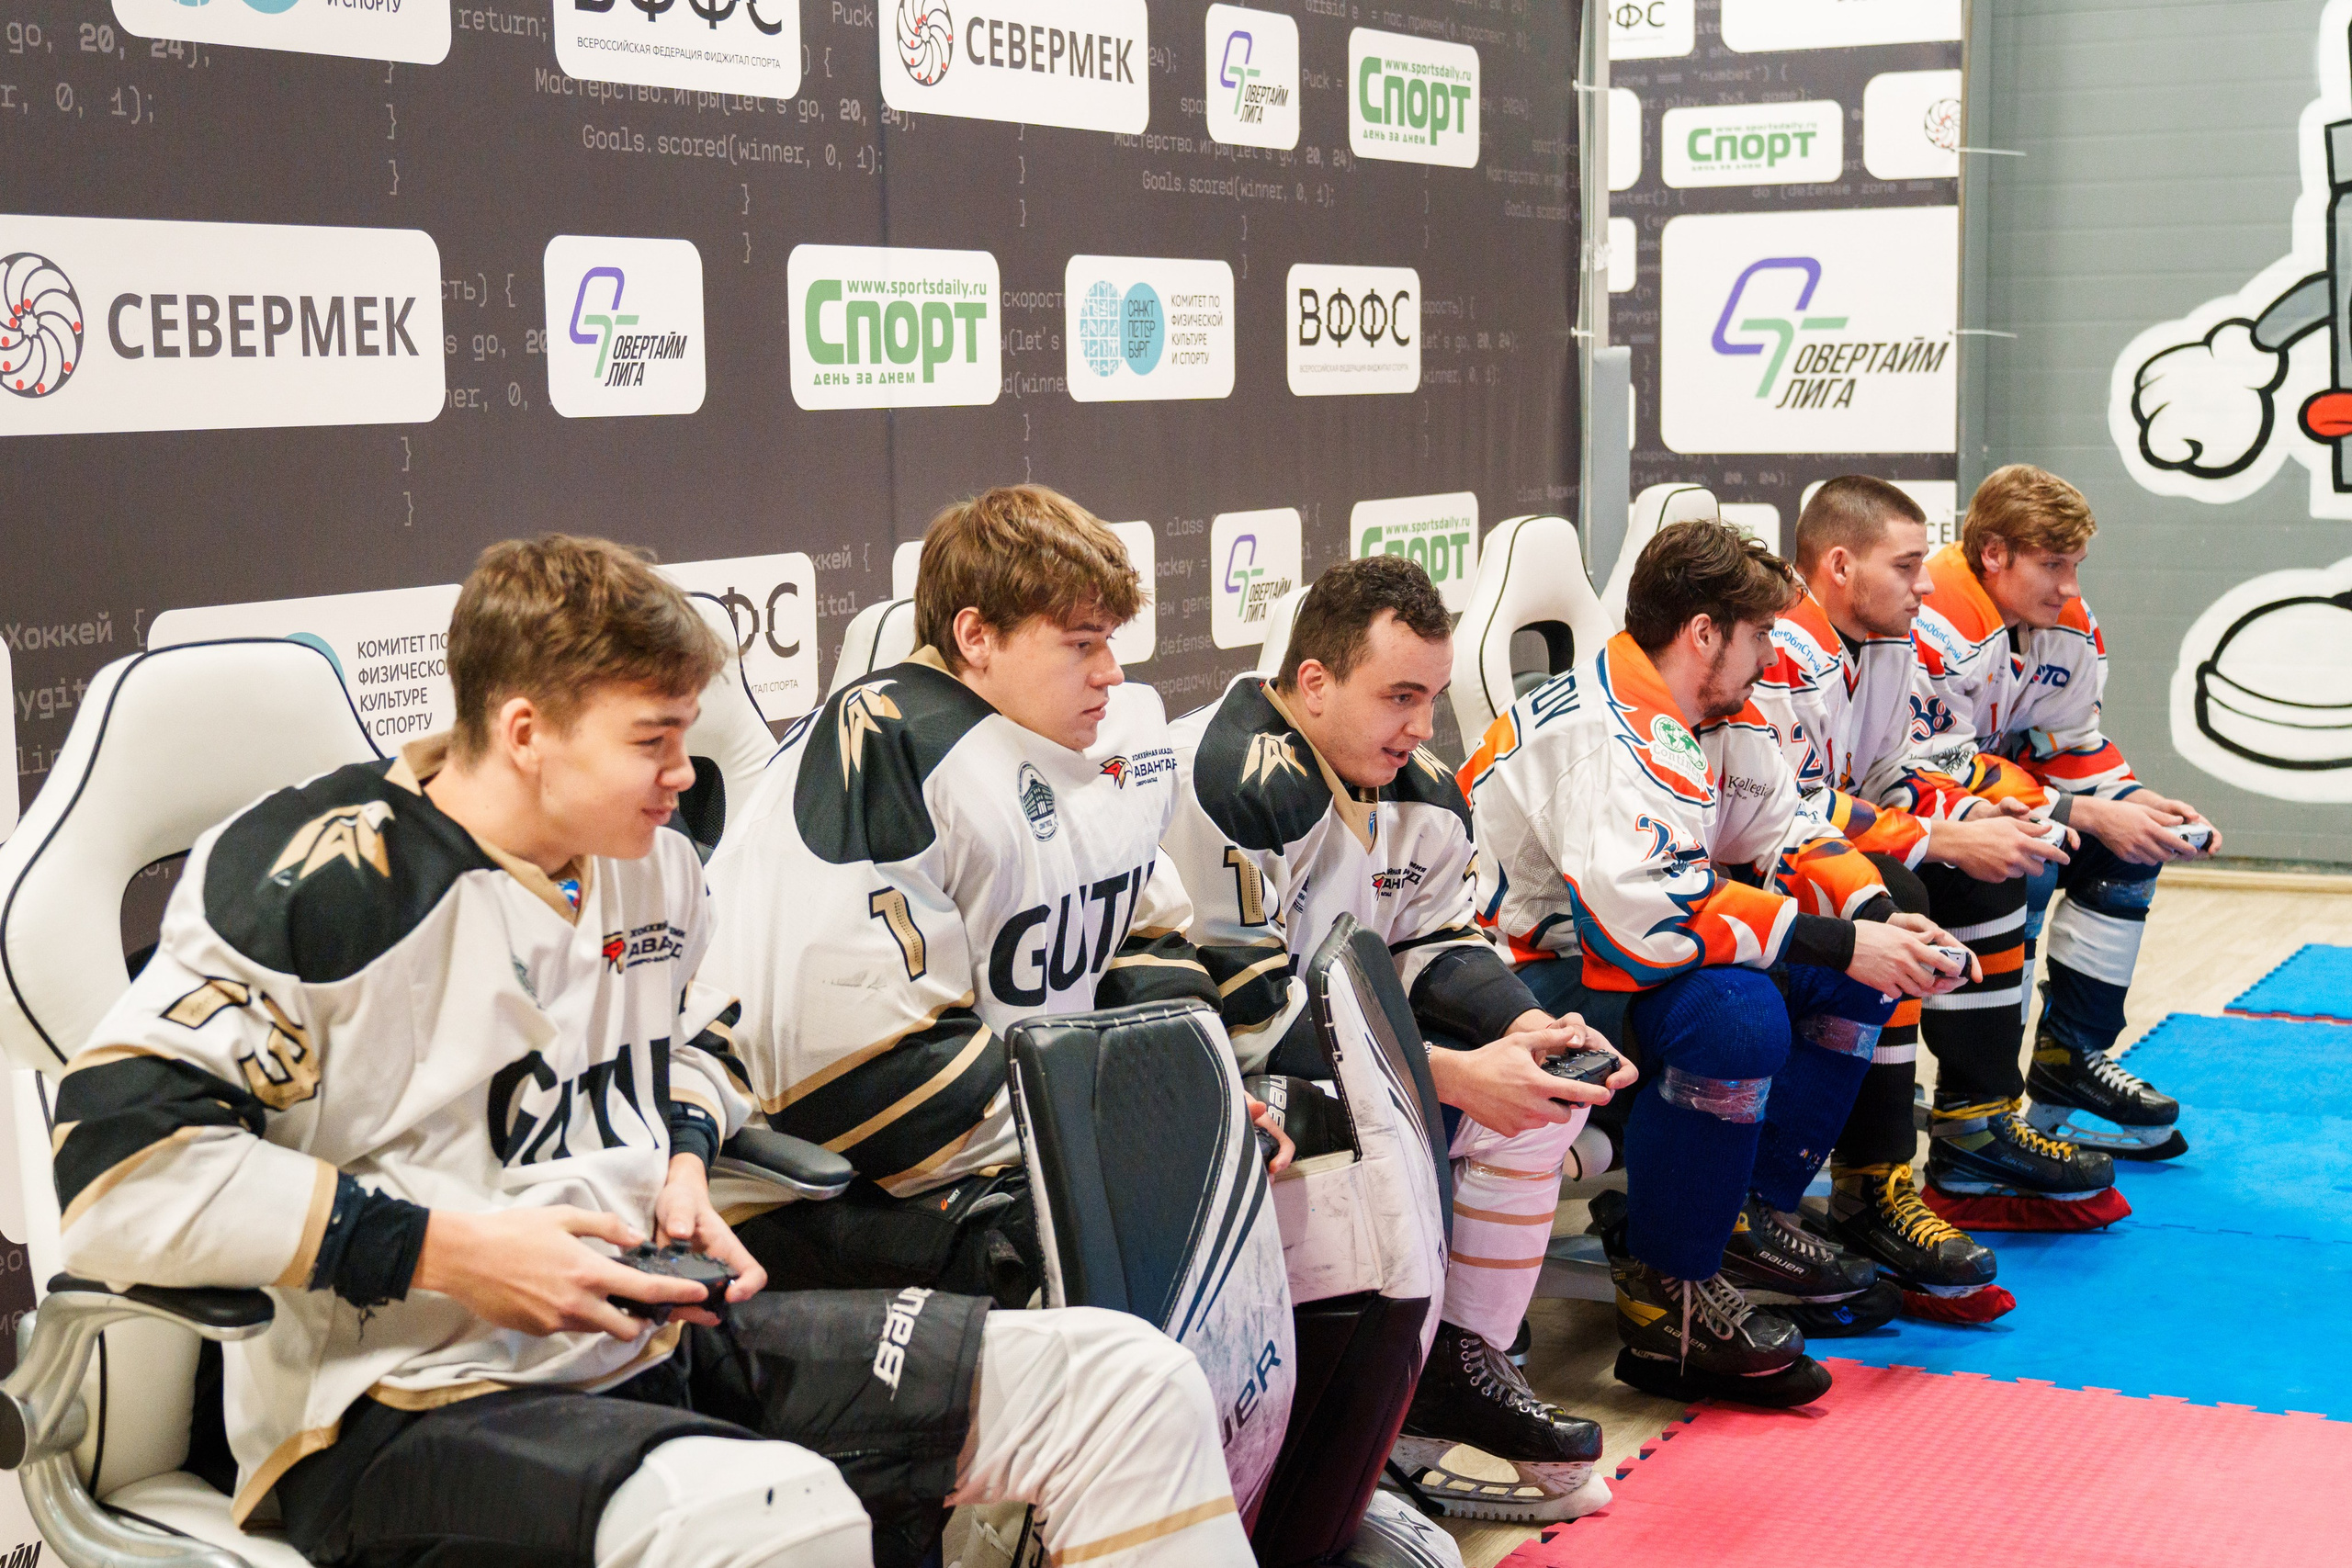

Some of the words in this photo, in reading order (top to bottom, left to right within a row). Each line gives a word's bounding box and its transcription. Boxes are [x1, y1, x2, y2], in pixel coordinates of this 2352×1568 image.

[459, 8, 548, 42] return;
[832, 1, 874, 28] Puck
[6, 21, 52, 54] go,
[79, 23, 125, 61] 20,
[577, 36, 650, 55] ВСЕРОССИЙСКАЯ
[652, 45, 702, 61] ФЕДЕРАЦИЯ
[704, 51, 749, 67] ФИДЖИТАЛ
[751, 56, 781, 69] СПОРТА
[966, 16, 1135, 85] СЕВЕРМЕК
[1385, 59, 1472, 83] www.sportsdaily.ru
[110, 85, 153, 125] 1);
[1244, 84, 1289, 107] ОВЕРТАЙМ
[1359, 56, 1471, 146] Спорт
[839, 98, 867, 127] 20,
[1239, 105, 1264, 125] ЛИГА
[582, 124, 810, 168] Goals.scored(winner,
[1363, 129, 1385, 141] день
[1388, 130, 1399, 142] за
[1402, 131, 1425, 145] днем
[1687, 127, 1816, 167] Спорт
[847, 278, 987, 299] www.sportsdaily.ru
[1170, 294, 1206, 308] КОМИТЕТ
[1209, 294, 1220, 308] ПО
[1002, 291, 1066, 314] скорост
[1127, 299, 1155, 318] САНКТ
[107, 291, 420, 360] СЕВЕРМЕК
[805, 278, 988, 384] Спорт
[1127, 320, 1156, 338] ПЕТЕР
[1170, 311, 1223, 327] ФИЗИЧЕСКОЙ
[1299, 288, 1409, 348] ВФФС
[613, 331, 687, 360] ОВЕРТАЙМ
[1128, 340, 1151, 358] БУРГ
[1171, 333, 1207, 346] КУЛЬТУРЕ
[1171, 353, 1177, 365] И
[1180, 352, 1210, 366] СПОРТУ
[1794, 337, 1950, 374] ОВЕРТАЙМ
[605, 362, 645, 387] ЛИГА
[814, 372, 850, 386] день
[856, 372, 873, 385] за
[878, 371, 915, 385] днем
[1775, 378, 1856, 409] ЛИГА
[1385, 516, 1470, 535] www.sportsdaily.ru
[1243, 602, 1267, 624] ЛИГА
[357, 636, 424, 659] КОМИТЕТ
[430, 633, 449, 650] ПО
[1916, 617, 1962, 661] енОблСтрой
[357, 658, 449, 686] ФИЗИЧЕСКО
[14, 677, 88, 721] ygit
[358, 687, 428, 712] КУЛЬТУРЕ
[770, 680, 798, 693] СПОРТА
[1529, 668, 1580, 729] OV
[376, 711, 433, 737] СПОРТУ
[1663, 1325, 1707, 1351] BAER
